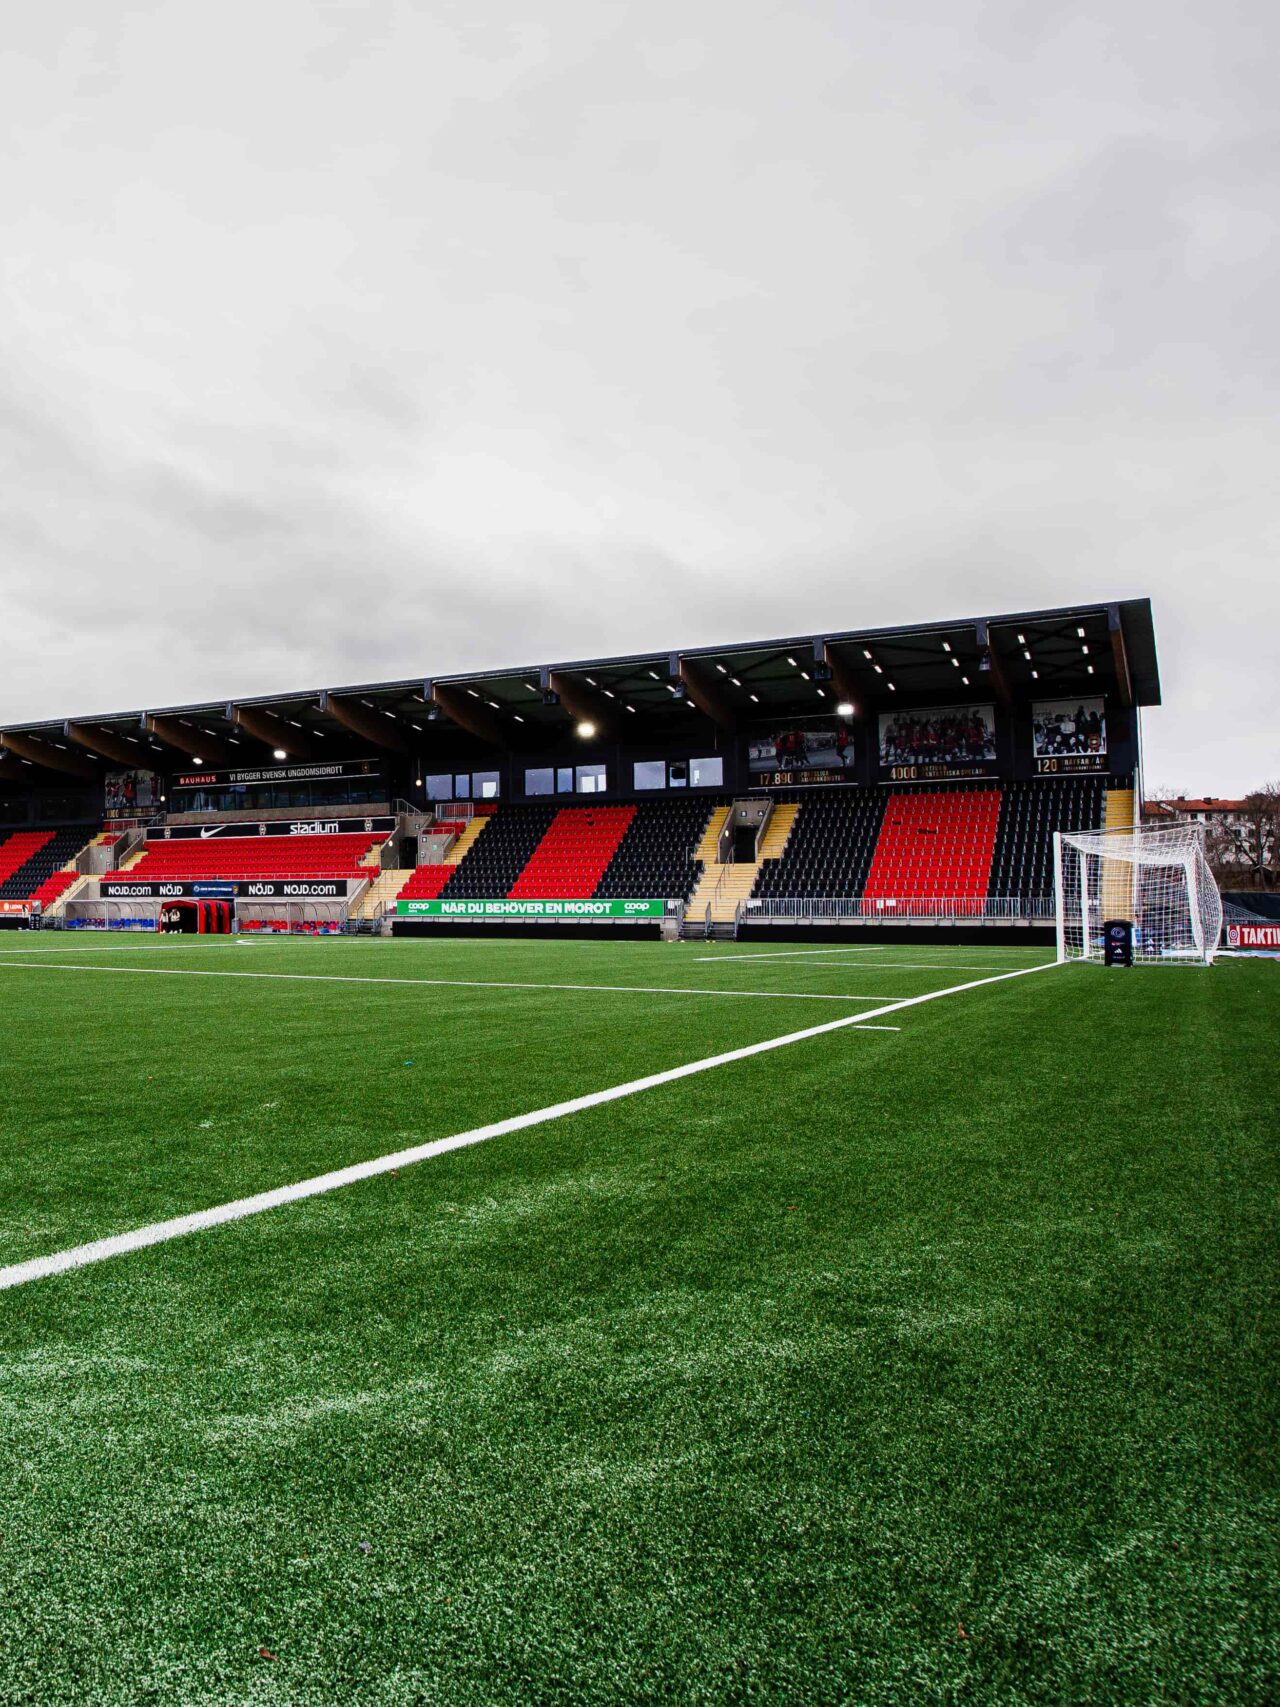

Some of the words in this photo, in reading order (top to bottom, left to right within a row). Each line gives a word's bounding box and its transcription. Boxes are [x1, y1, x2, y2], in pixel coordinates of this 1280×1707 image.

[1038, 759, 1057, 772] 120
[180, 775, 216, 785] BAUHAUS
[230, 773, 236, 781] VI
[237, 771, 261, 781] BYGGER
[262, 769, 287, 779] SVENSK
[287, 765, 343, 777] UNGDOMSIDROTT
[760, 772, 794, 785] 17.890
[890, 766, 917, 780] 4000
[289, 821, 339, 835] stadium
[108, 886, 152, 896] NOJD.com
[160, 883, 183, 895] NÖJD
[248, 883, 274, 895] NÖJD
[283, 885, 336, 895] NOJD.com
[408, 902, 429, 911] coop
[441, 902, 466, 913] NÄR
[467, 902, 484, 913] DU
[485, 902, 543, 914] BEHÖVER
[546, 902, 564, 914] EN
[564, 902, 612, 914] MOROT
[624, 902, 650, 911] coop
